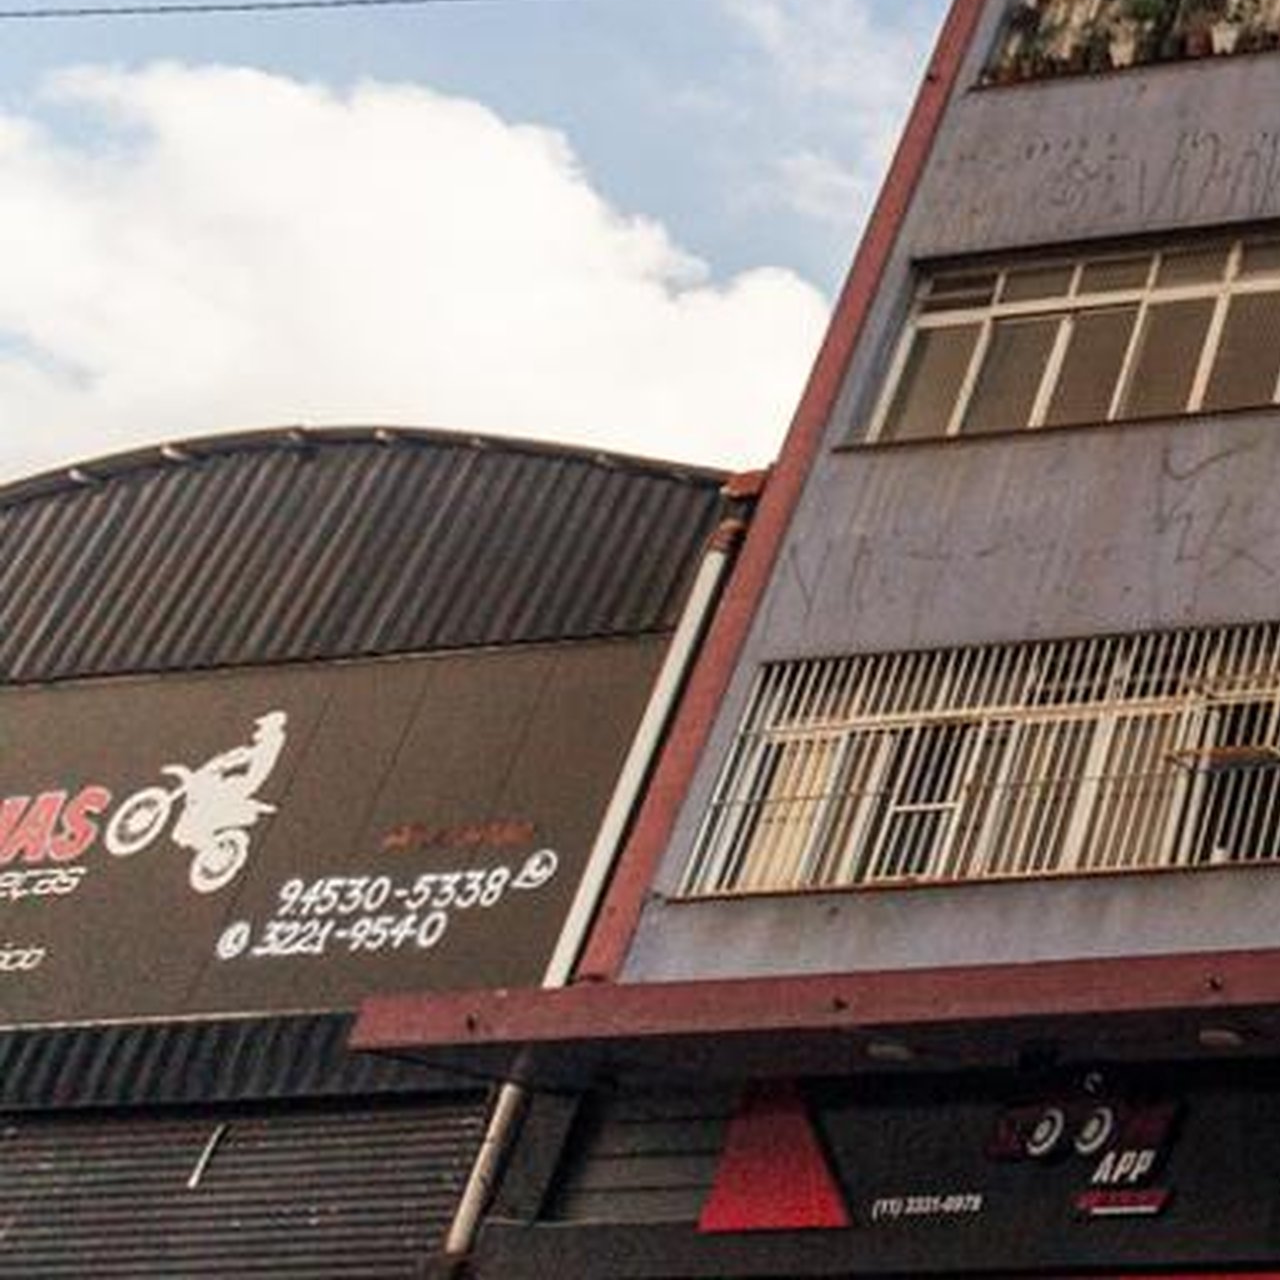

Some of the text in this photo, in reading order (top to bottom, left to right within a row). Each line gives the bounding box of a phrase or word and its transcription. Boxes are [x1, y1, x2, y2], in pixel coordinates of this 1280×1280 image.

[278, 867, 511, 917] 94530-5338
[255, 912, 447, 955] 3221-9540
[1091, 1150, 1155, 1183] APP
